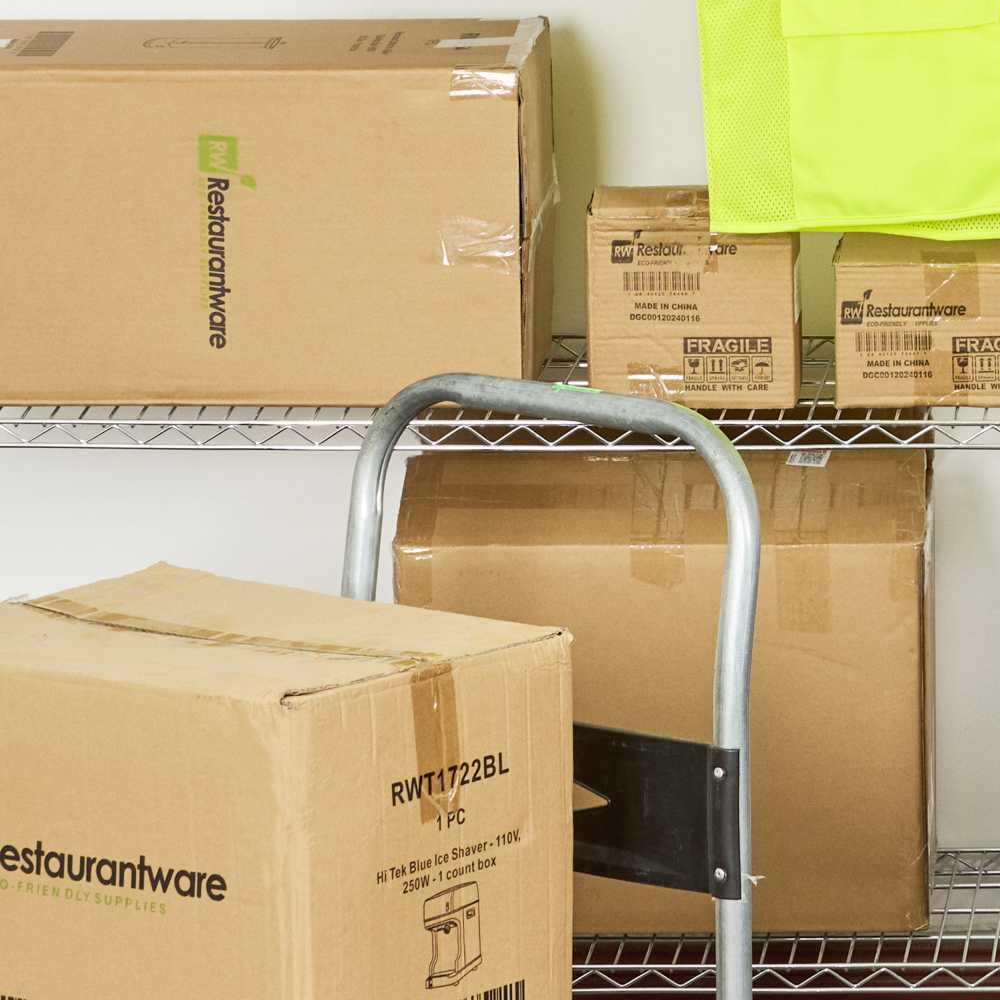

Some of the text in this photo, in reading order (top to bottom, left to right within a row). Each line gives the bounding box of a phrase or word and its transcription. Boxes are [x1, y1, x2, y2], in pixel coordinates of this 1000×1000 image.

[614, 246, 633, 258] RW
[207, 177, 231, 349] Restaurantware
[635, 302, 698, 311] MADE IN CHINA
[844, 302, 967, 319] RW Restaurantware
[629, 314, 701, 322] DGC00120240116
[687, 338, 770, 353] FRAGILE
[904, 359, 930, 367] CHINA
[862, 371, 933, 379] DGC00120240116
[954, 383, 987, 391] HANDLE
[391, 752, 510, 807] RWT1722BL
[436, 808, 466, 831] 1 PC
[376, 870, 387, 885] Hi
[389, 865, 407, 880] Tek
[409, 858, 432, 874] Blue
[434, 853, 449, 867] Ice
[451, 840, 488, 861] Shaver
[495, 829, 521, 848] 110V,
[402, 874, 430, 894] 250W
[438, 870, 443, 882] 1
[446, 861, 476, 880] count
[477, 856, 497, 871] box
[94, 892, 168, 915] SUPPLIES
